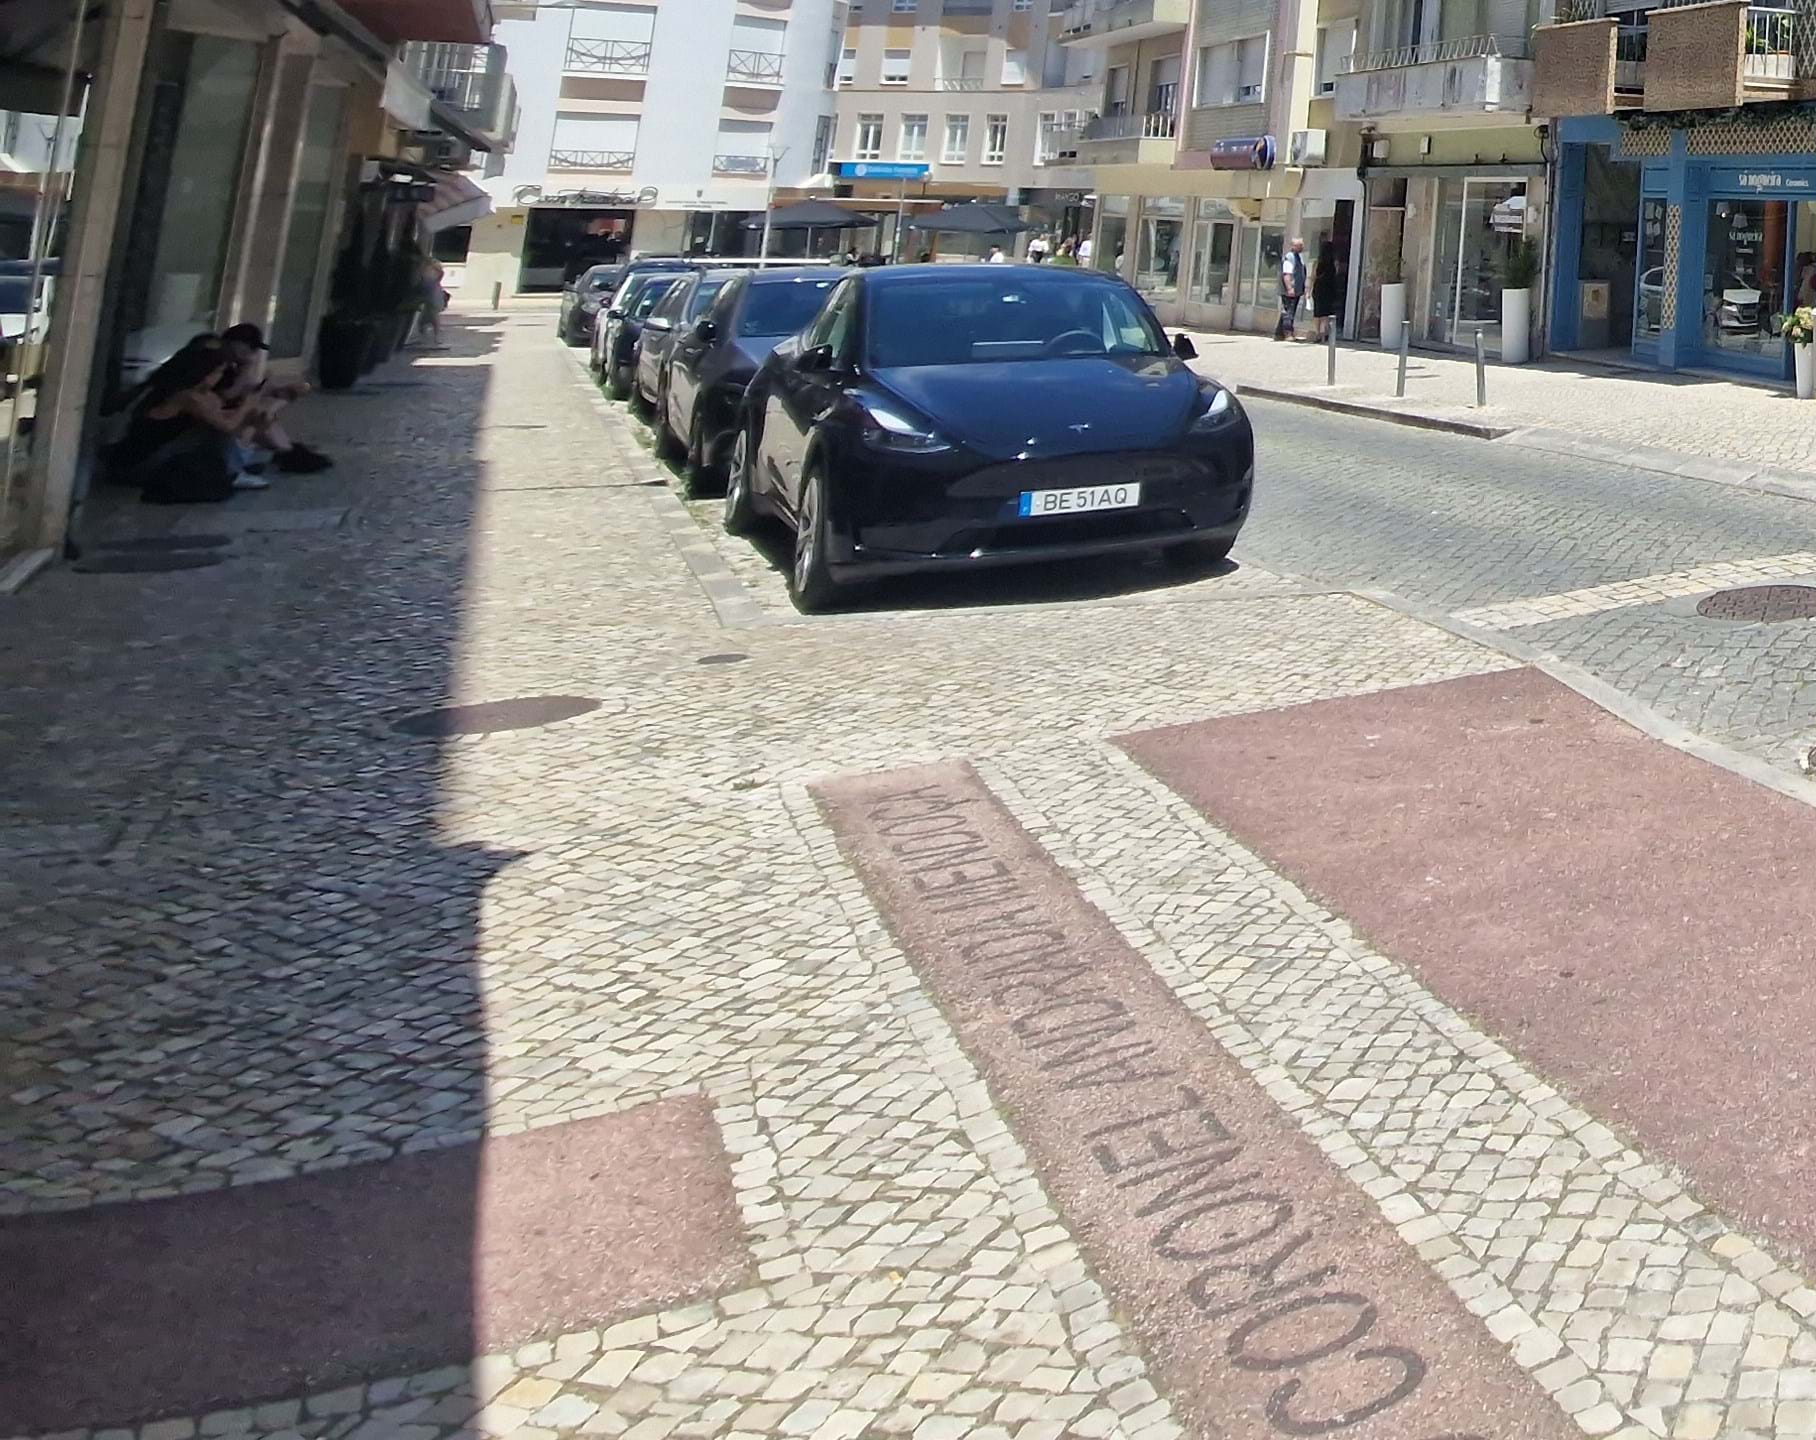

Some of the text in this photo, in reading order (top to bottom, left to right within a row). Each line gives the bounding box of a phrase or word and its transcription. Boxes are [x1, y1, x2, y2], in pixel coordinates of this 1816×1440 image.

[861, 783, 1428, 1438] CORONEL ANDRADA MENDOÇA
